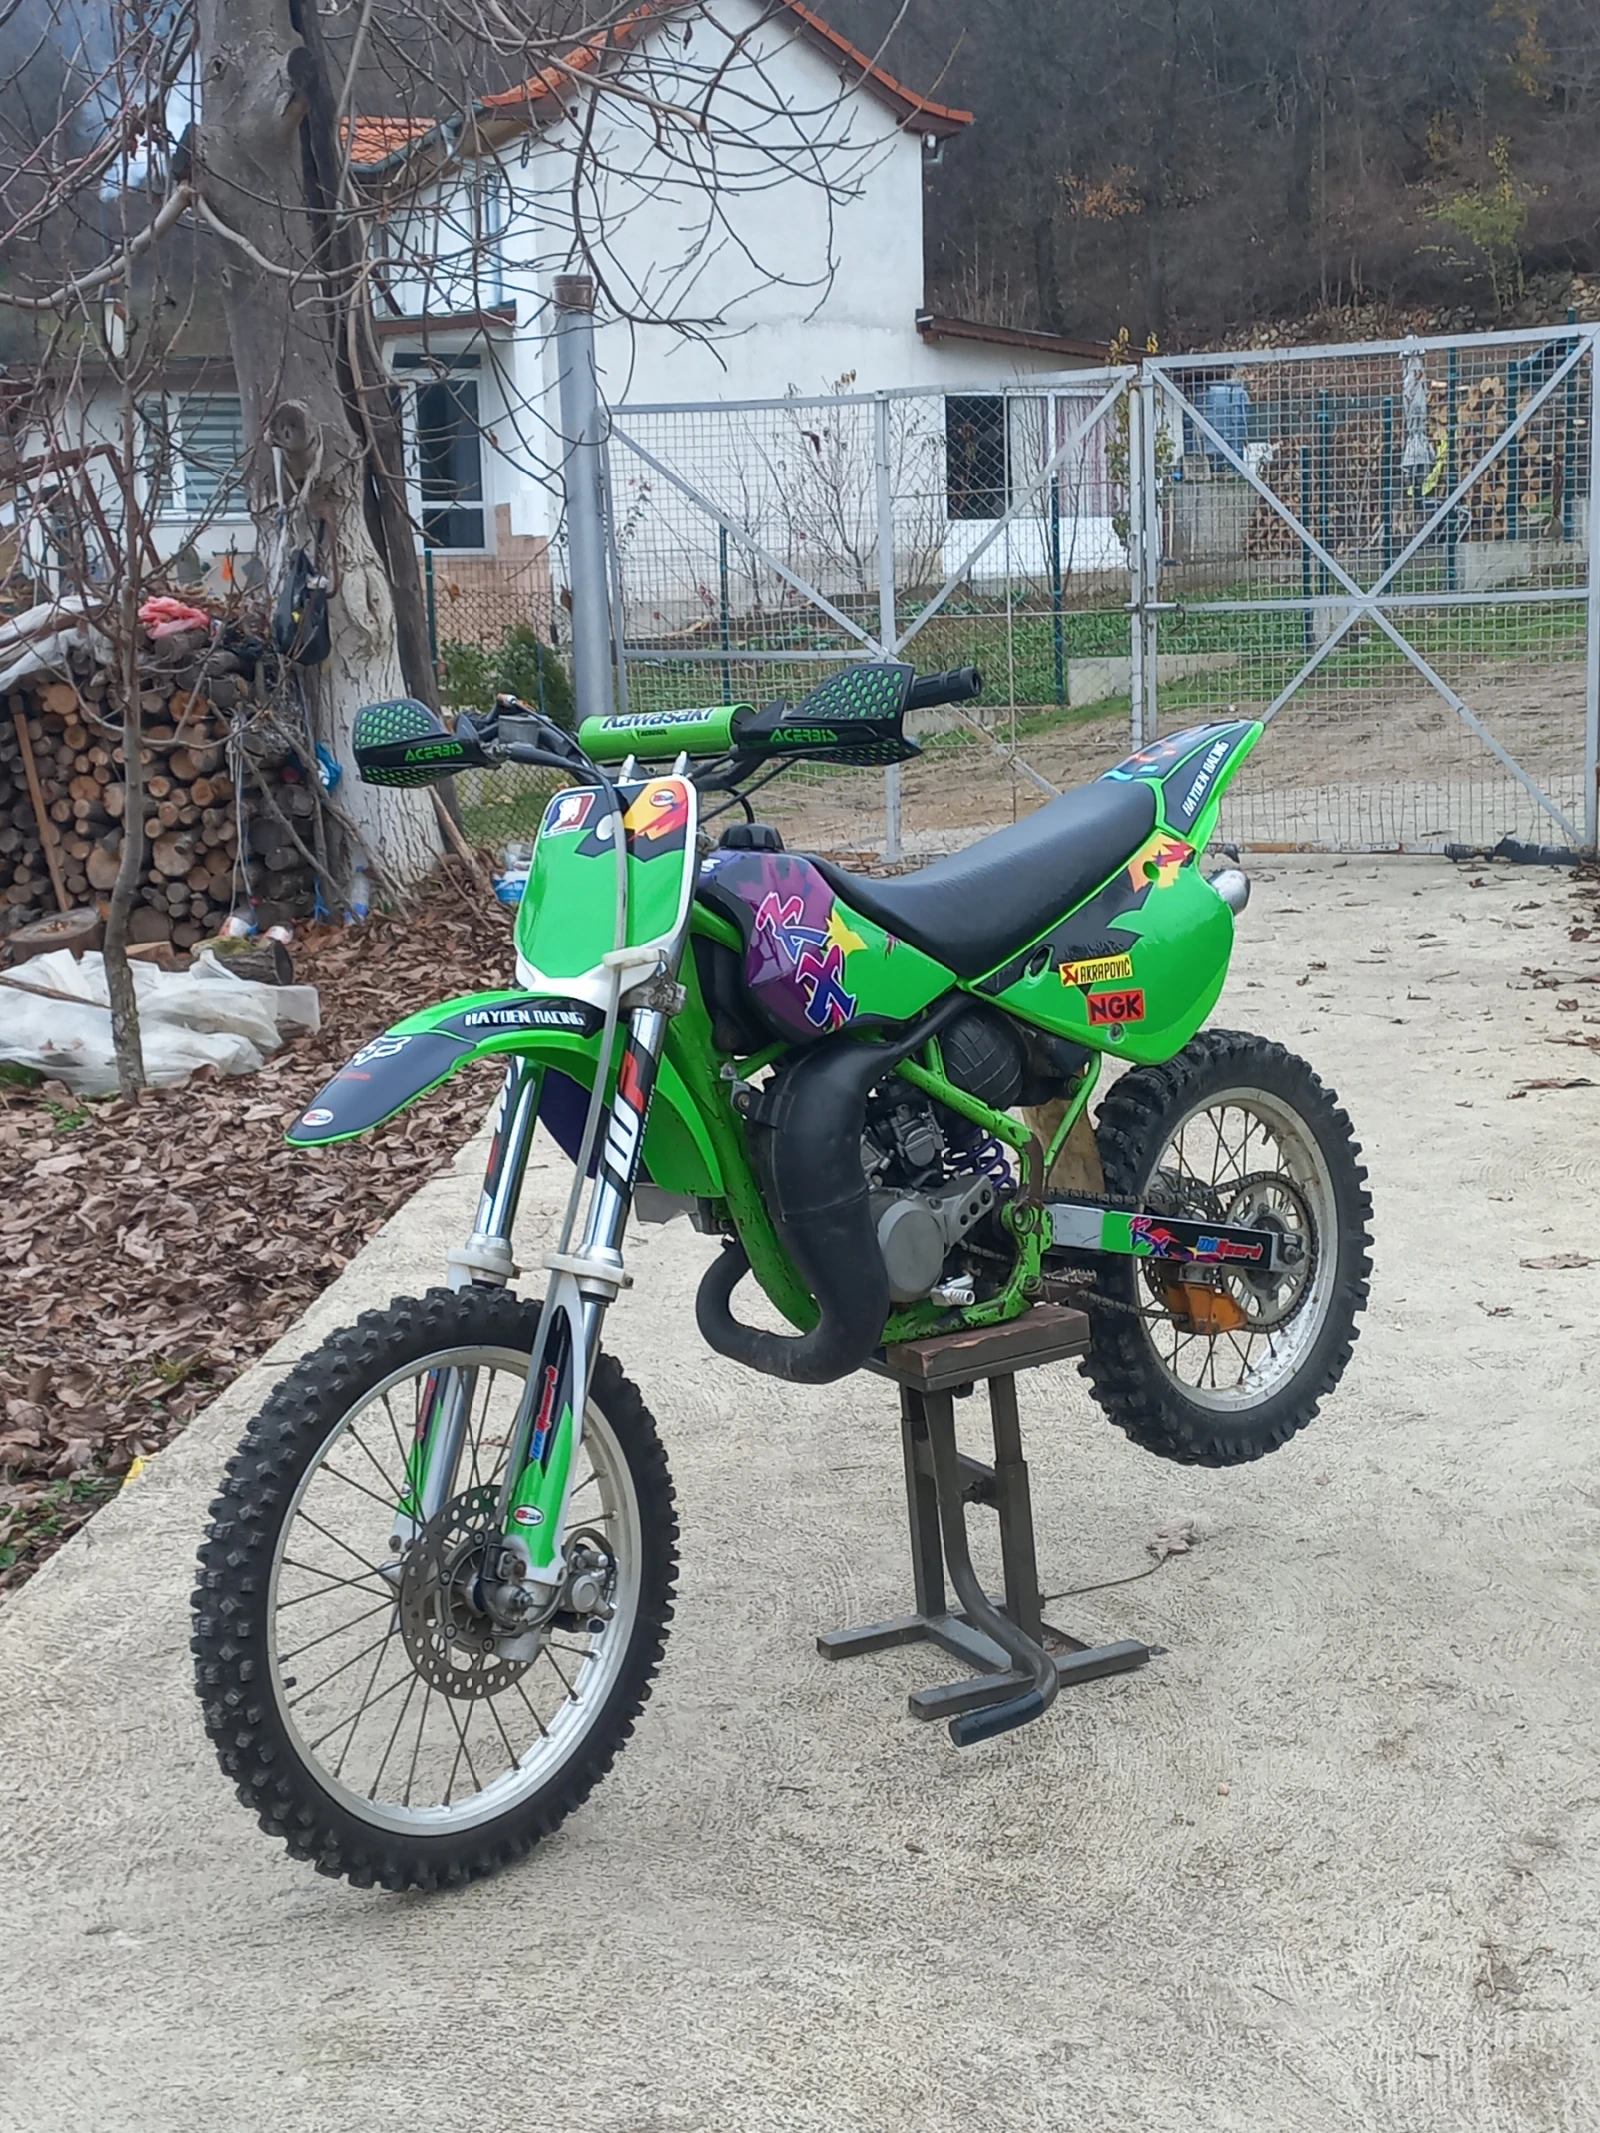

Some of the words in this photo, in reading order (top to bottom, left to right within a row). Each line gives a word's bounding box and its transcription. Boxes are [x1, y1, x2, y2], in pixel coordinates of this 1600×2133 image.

[1183, 768, 1210, 817] HAYDEN
[465, 1010, 531, 1026] HAYDEN
[532, 1010, 585, 1026] RACING
[1089, 994, 1141, 1021] NGK
